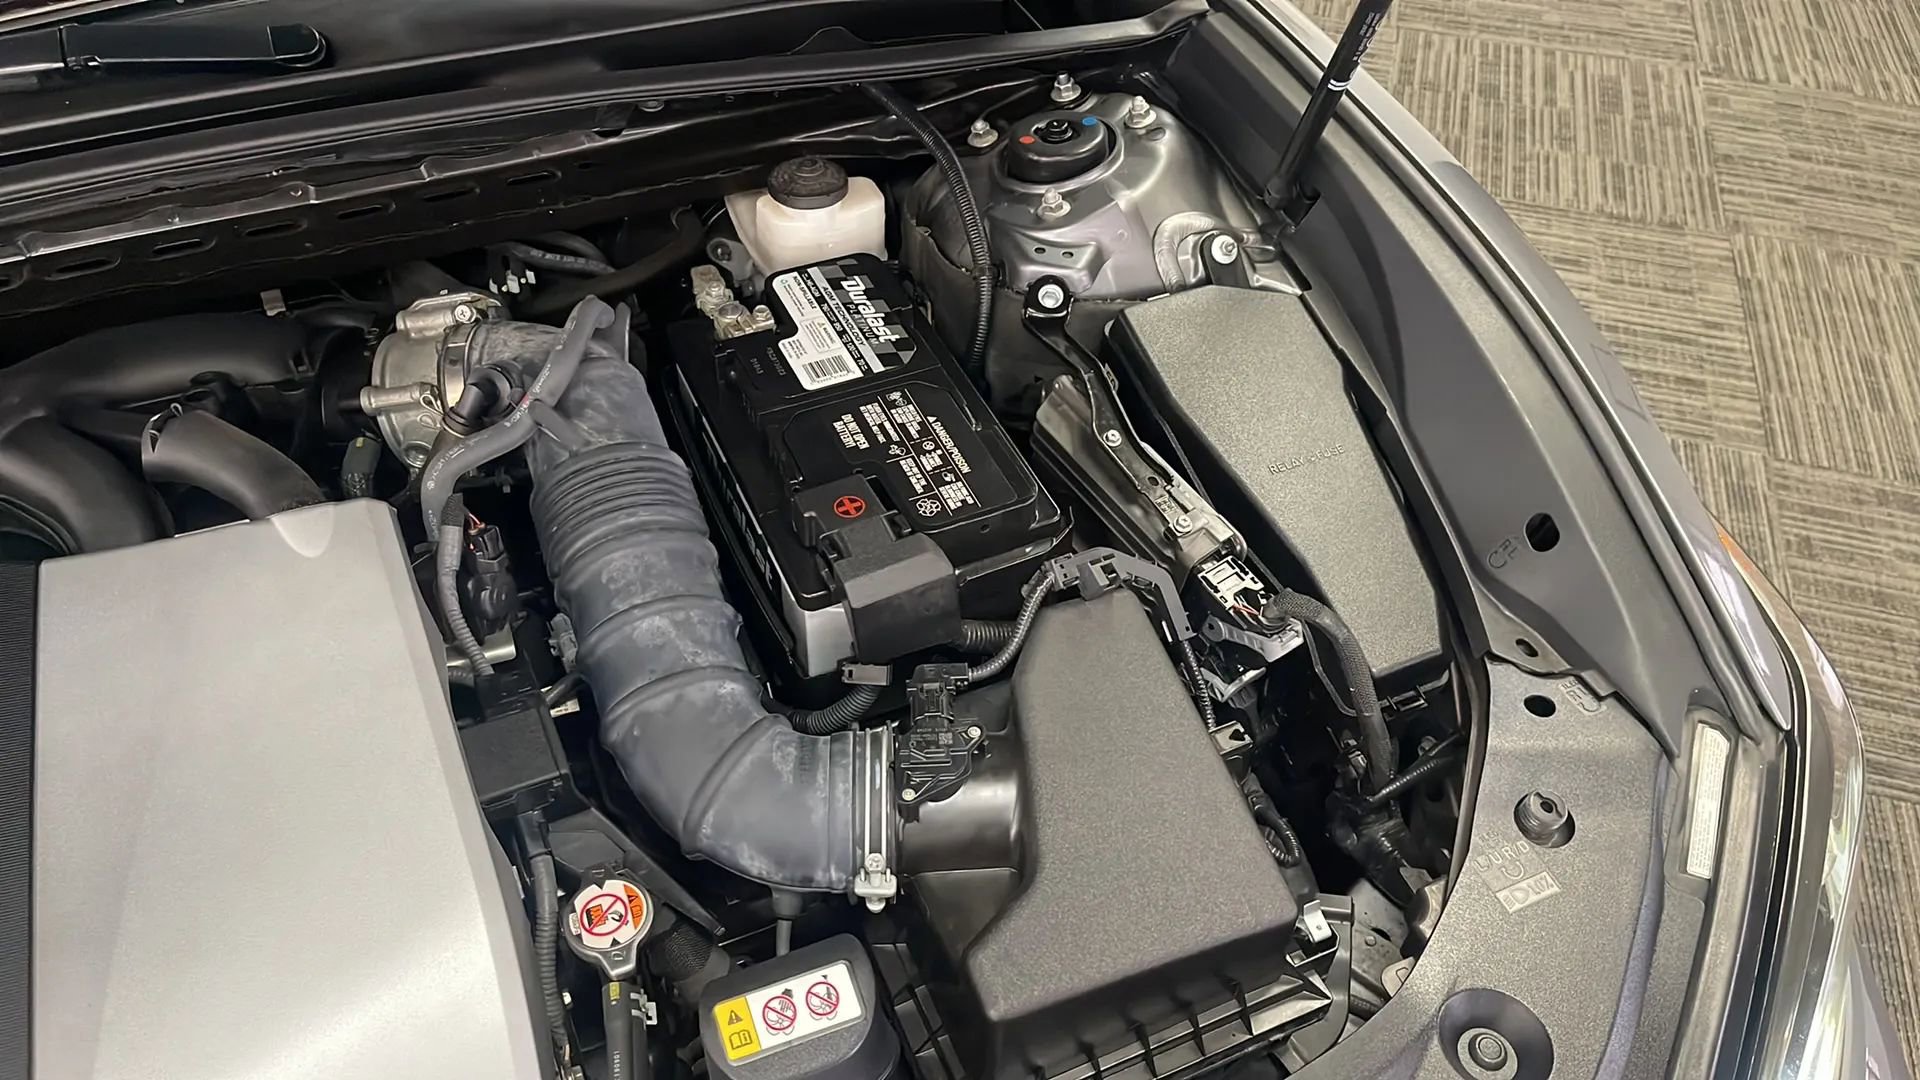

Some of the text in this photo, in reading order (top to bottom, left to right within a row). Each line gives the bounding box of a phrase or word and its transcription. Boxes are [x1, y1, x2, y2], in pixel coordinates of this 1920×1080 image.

[822, 285, 866, 347] AGM TECHNOLOGY
[840, 275, 900, 343] Duralast
[846, 304, 880, 345] PLATINUM
[841, 413, 870, 450] DO NOT OPEN
[932, 421, 972, 474] DANGER/POISON
[1268, 455, 1306, 475] RELAY
[1315, 444, 1346, 461] FUSE
